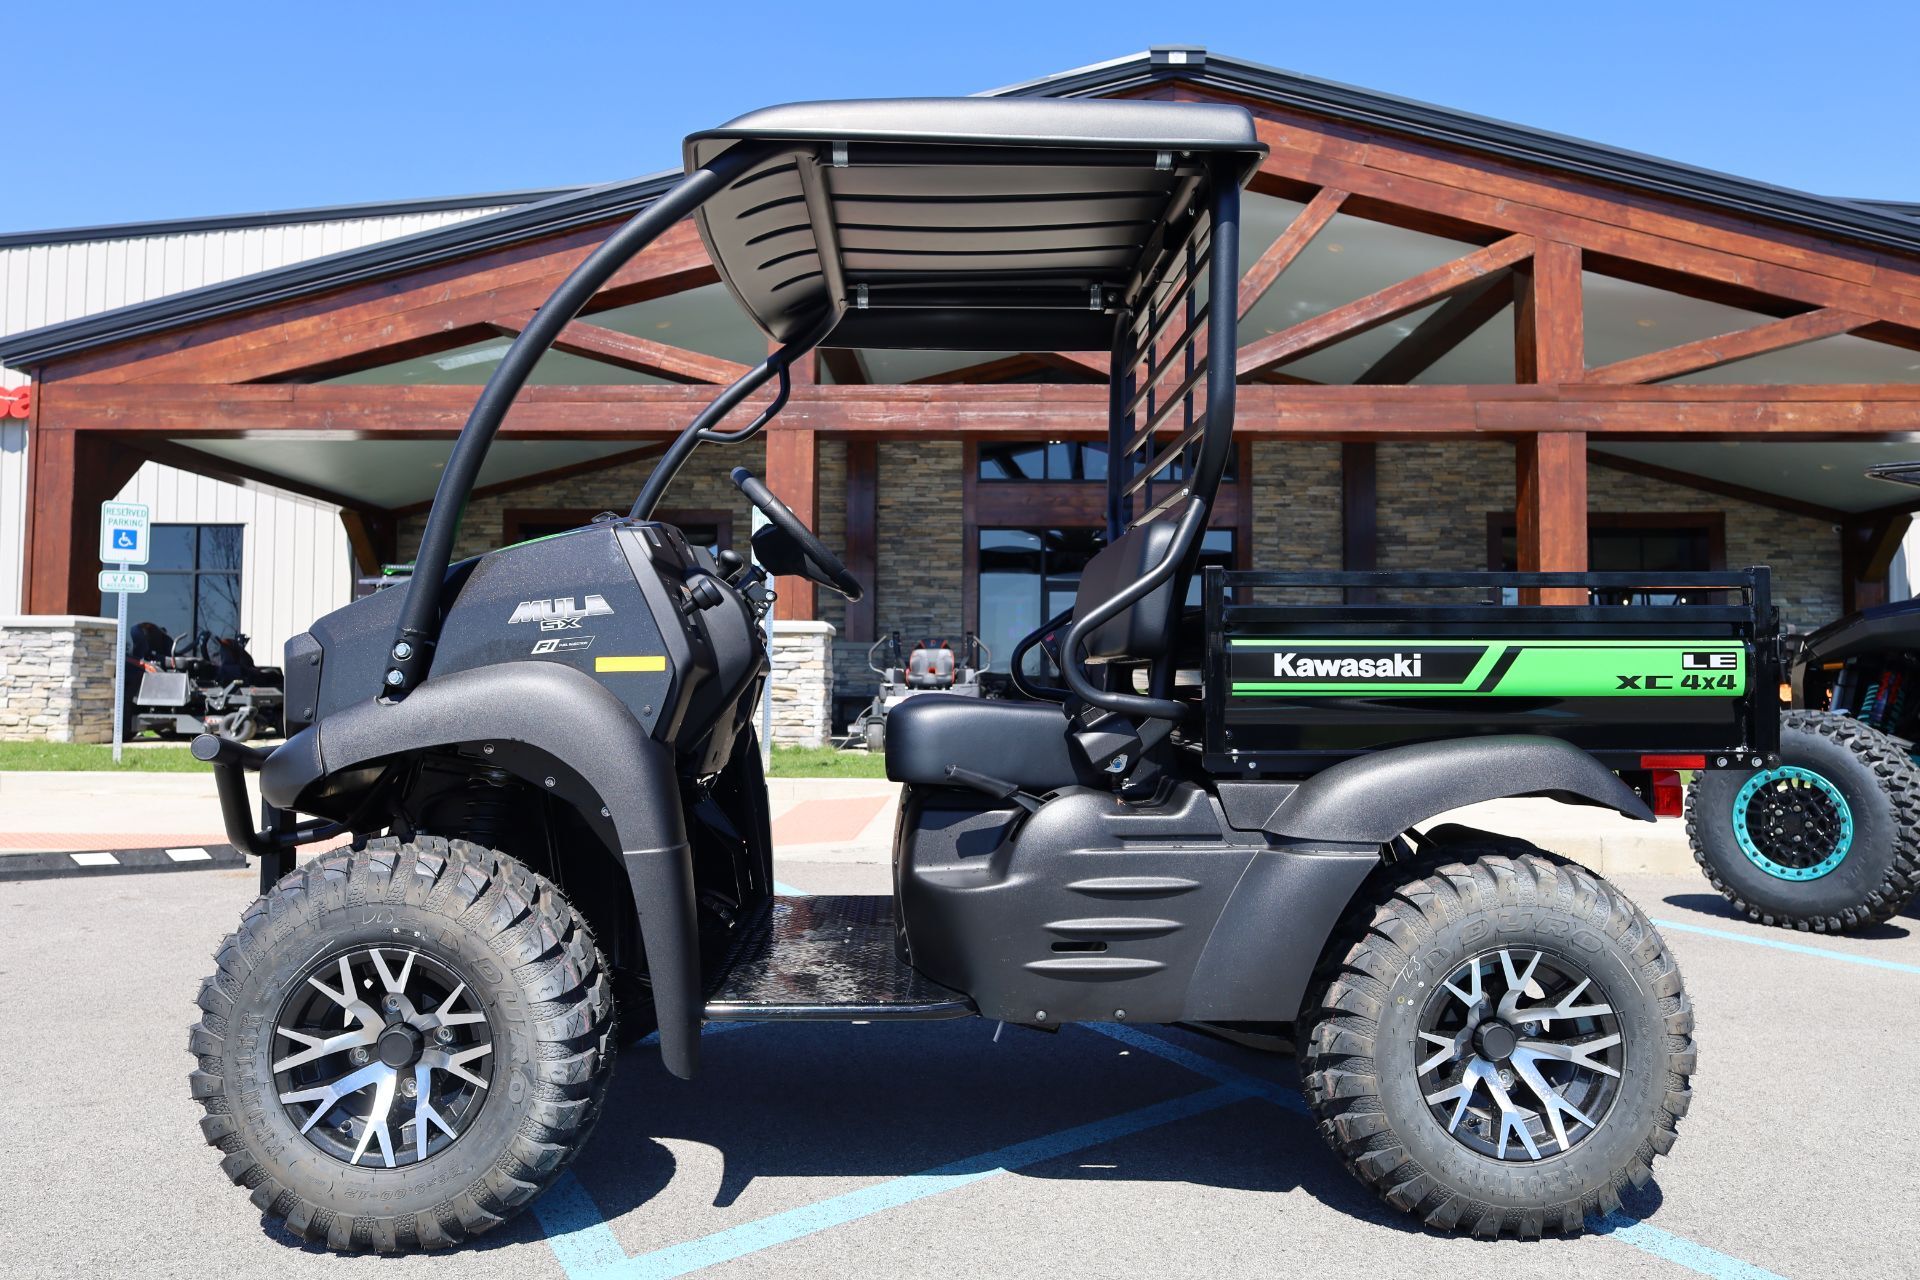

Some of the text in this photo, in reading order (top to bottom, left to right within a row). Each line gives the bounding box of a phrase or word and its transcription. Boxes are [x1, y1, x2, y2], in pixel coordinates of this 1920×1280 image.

[106, 507, 146, 518] RESERVED
[108, 518, 143, 528] PARKING
[112, 574, 136, 583] VAN
[540, 616, 582, 632] SX
[1274, 652, 1421, 678] Kawasaki
[1682, 653, 1736, 669] LE
[1615, 674, 1737, 690] XC 4x4
[1462, 913, 1603, 954] DURO
[471, 956, 529, 1105] DURO
